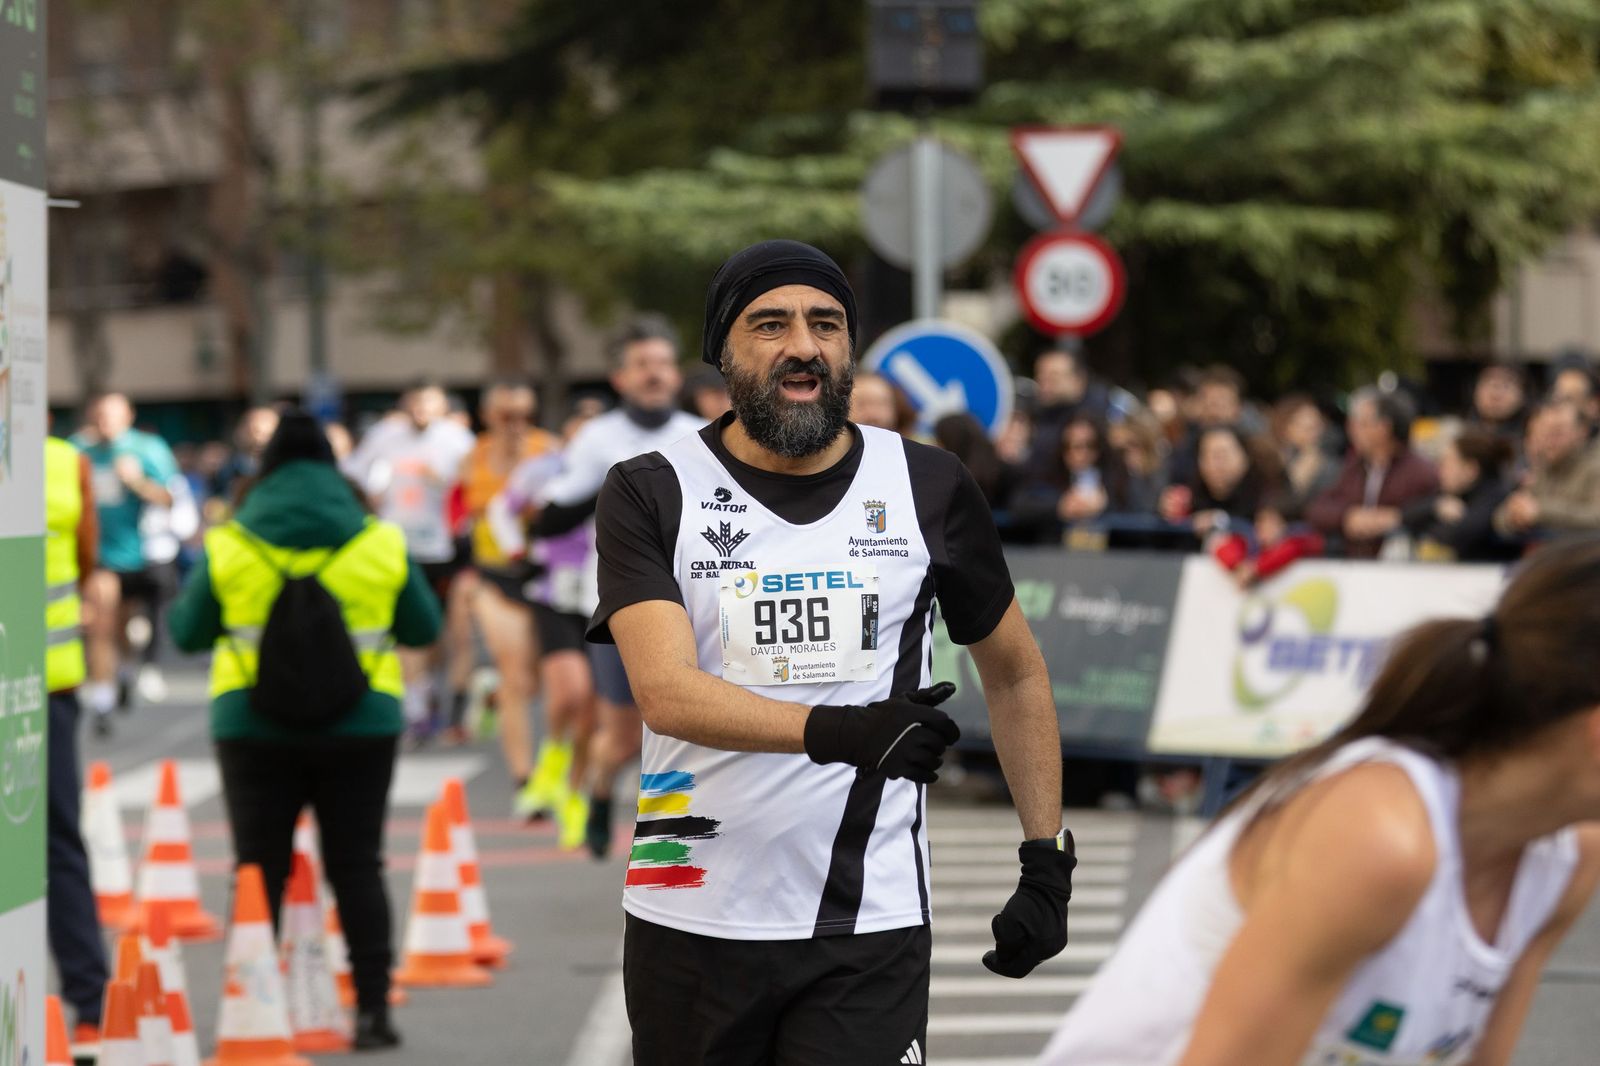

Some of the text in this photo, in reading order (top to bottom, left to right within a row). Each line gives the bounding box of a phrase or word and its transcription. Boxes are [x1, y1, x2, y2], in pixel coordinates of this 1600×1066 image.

[701, 501, 748, 514] VIATOR
[848, 536, 908, 548] Ayuntamiento
[849, 548, 909, 558] de Salamanca
[690, 560, 757, 571] CAJA RURAL
[690, 571, 703, 579] DE
[762, 571, 864, 593] SETEL
[754, 596, 831, 646] 936
[750, 642, 837, 656] DAVID MORALES
[792, 661, 836, 671] Ayuntamiento
[792, 671, 836, 680] de Salamanca
